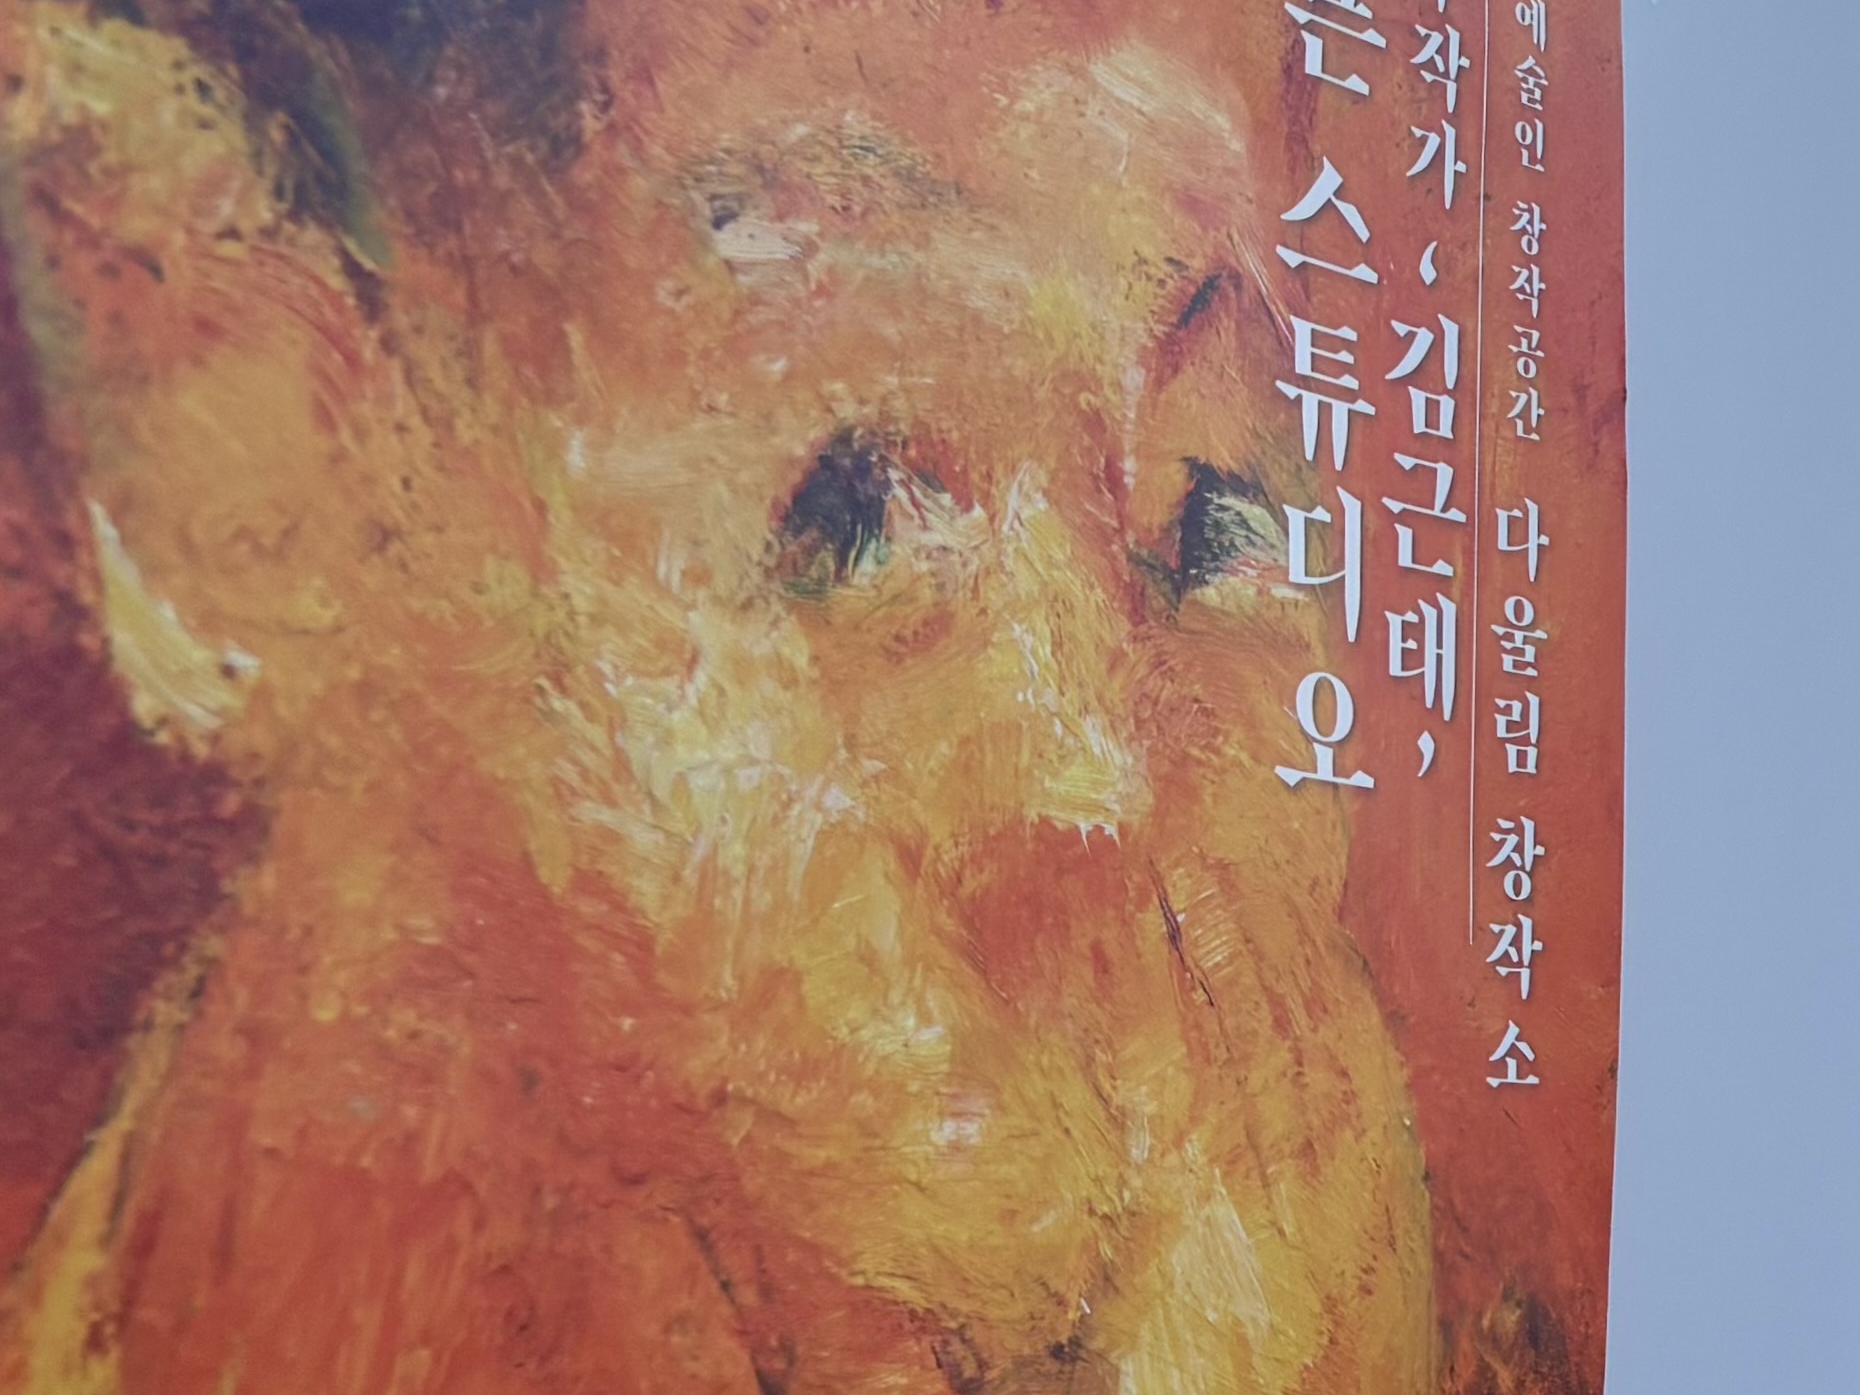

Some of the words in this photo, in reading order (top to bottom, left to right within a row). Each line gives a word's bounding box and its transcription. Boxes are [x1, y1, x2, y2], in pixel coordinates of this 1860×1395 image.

[1506, 200, 1546, 441] 창작공간
[1274, 155, 1380, 790] 스튜디오
[1491, 497, 1549, 775] 다울림
[1486, 815, 1545, 1088] 창작소
